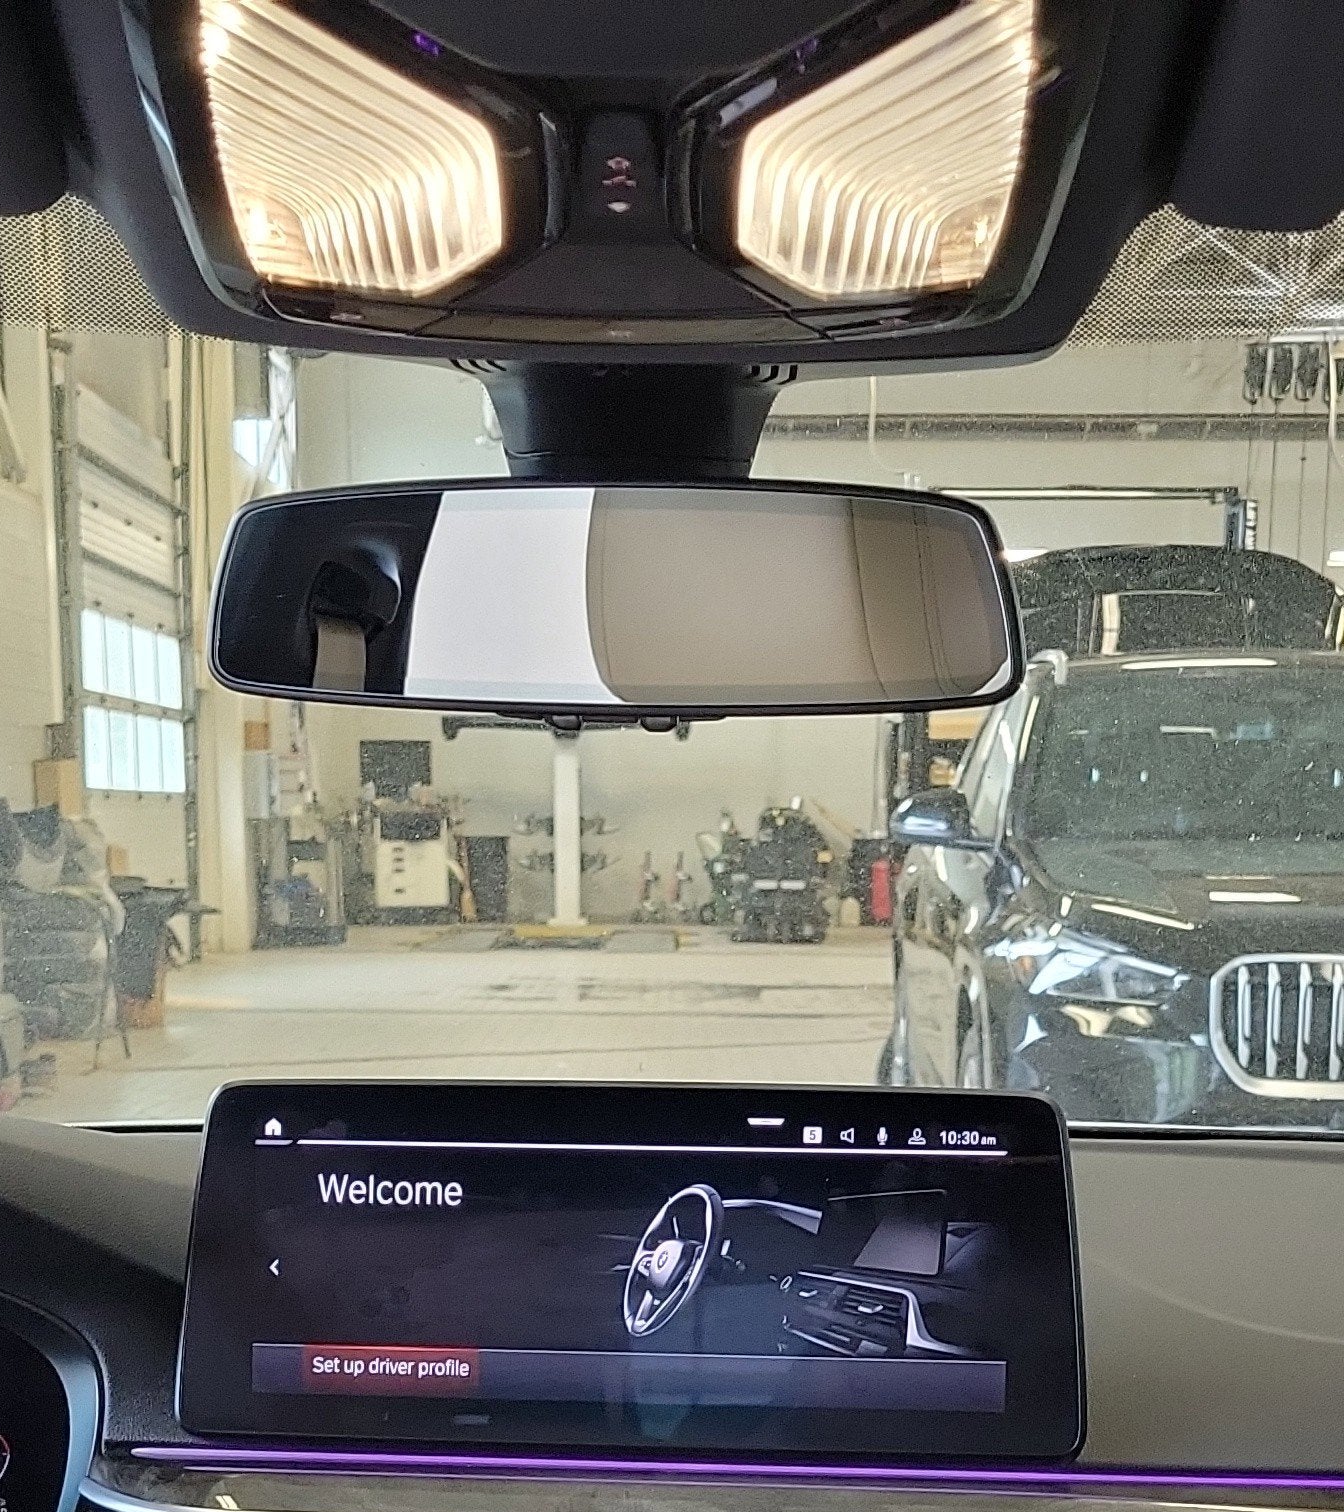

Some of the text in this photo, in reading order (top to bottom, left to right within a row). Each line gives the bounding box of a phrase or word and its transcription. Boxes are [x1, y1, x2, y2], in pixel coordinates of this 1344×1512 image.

[317, 1173, 463, 1207] Welcome
[312, 1356, 471, 1379] Set up driver profile
